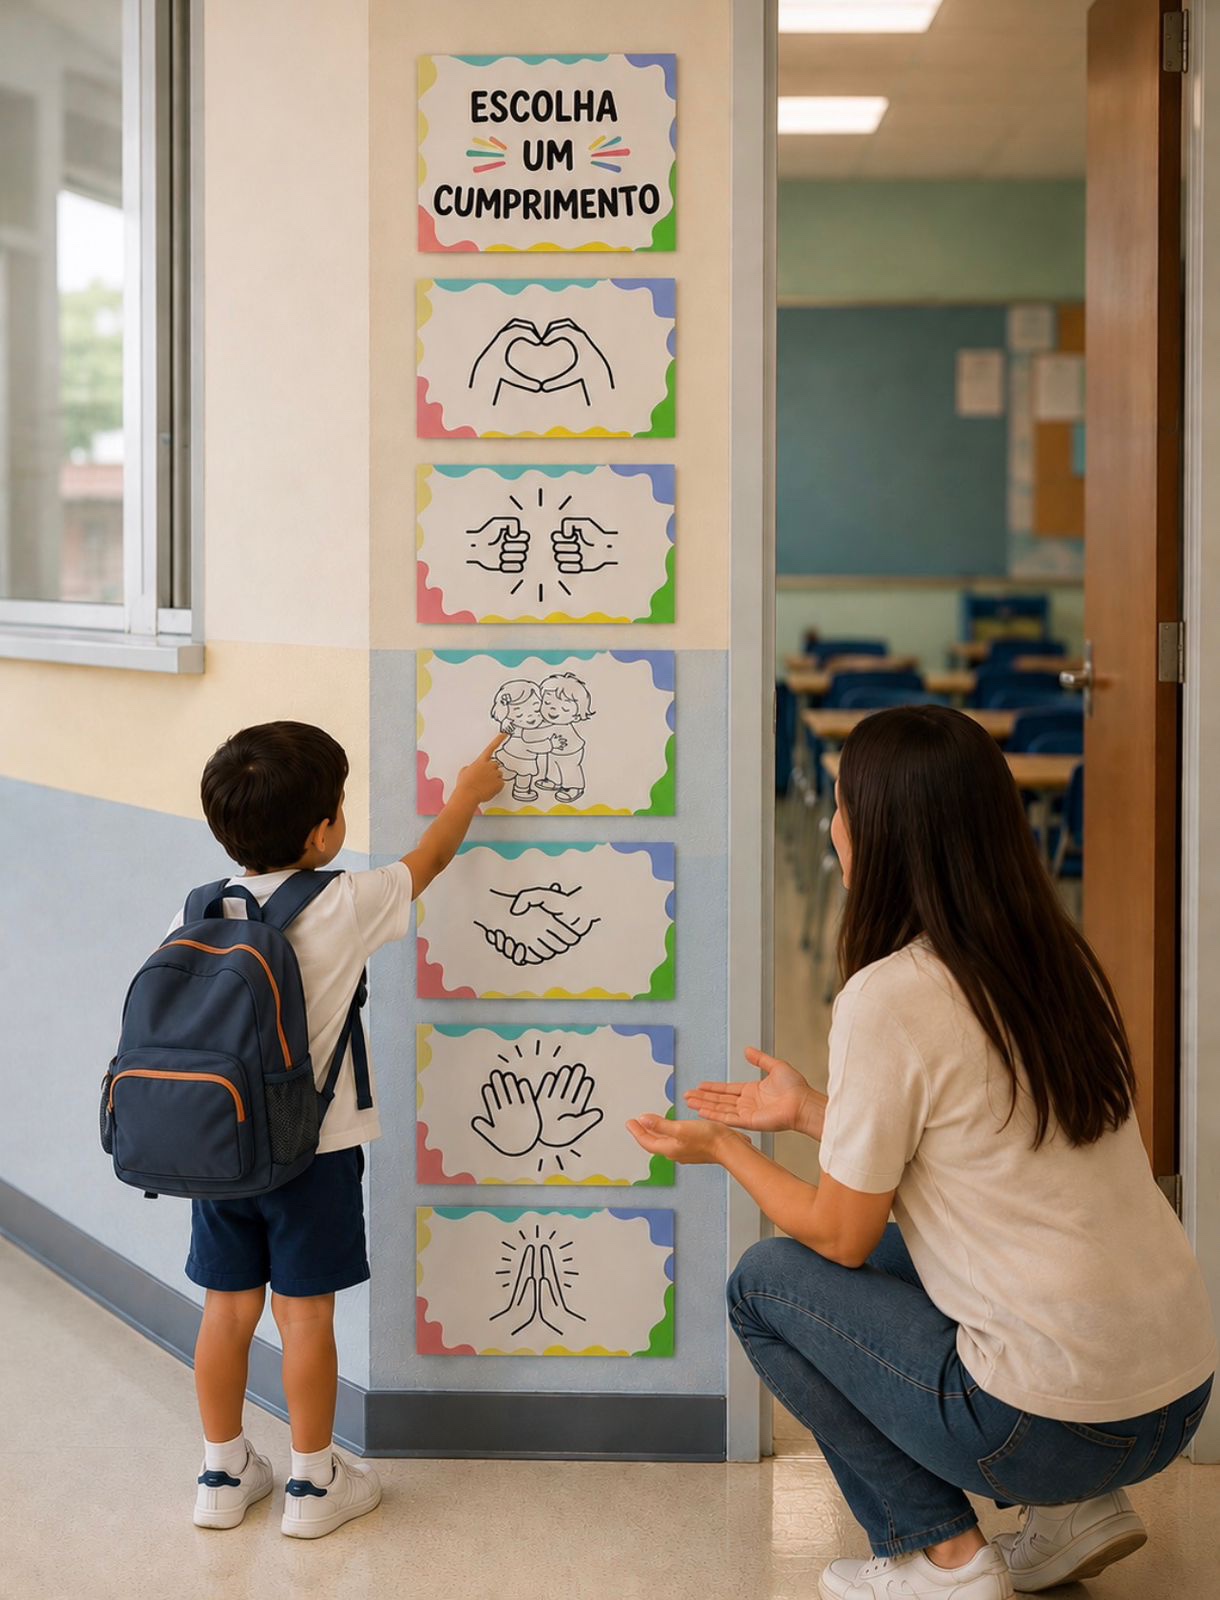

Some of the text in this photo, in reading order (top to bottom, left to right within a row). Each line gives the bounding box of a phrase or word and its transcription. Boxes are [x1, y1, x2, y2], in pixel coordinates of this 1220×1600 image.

[471, 89, 618, 123] ESCOLHA
[523, 139, 574, 172] UM
[433, 183, 660, 220] CUMPRIMENTO
